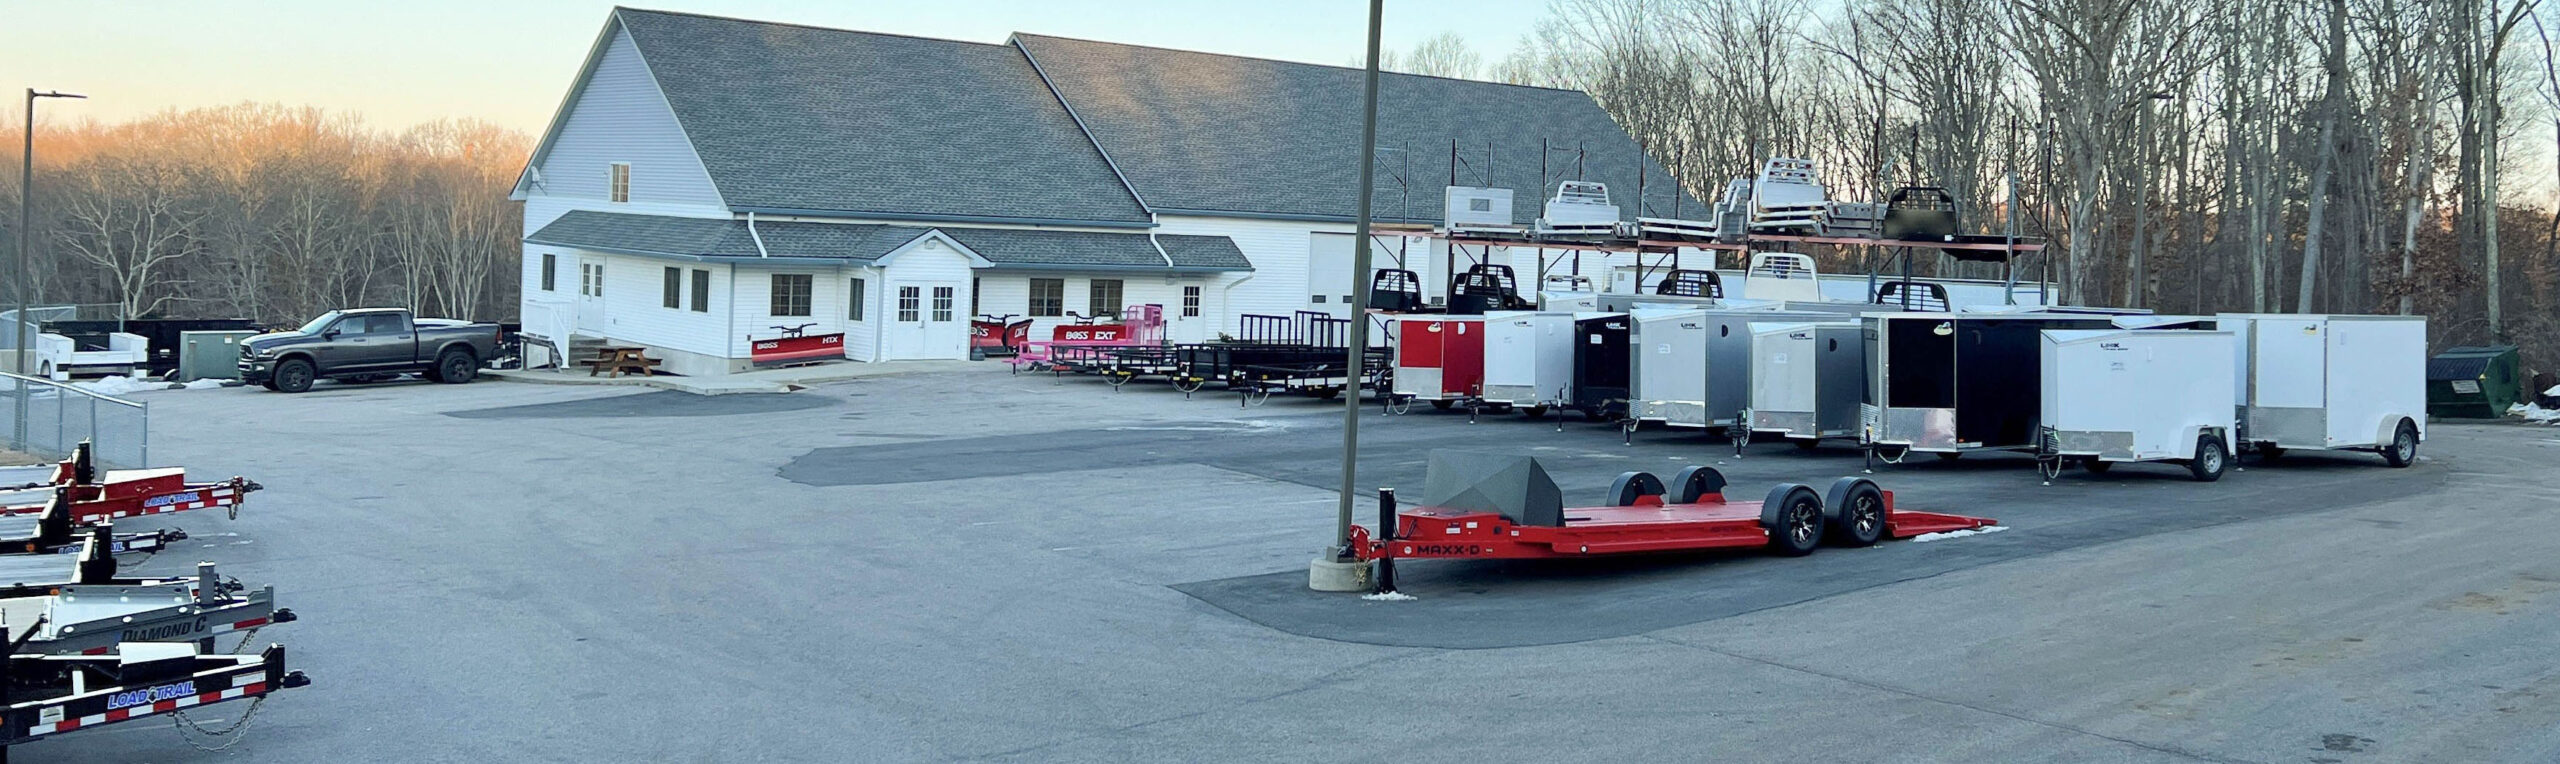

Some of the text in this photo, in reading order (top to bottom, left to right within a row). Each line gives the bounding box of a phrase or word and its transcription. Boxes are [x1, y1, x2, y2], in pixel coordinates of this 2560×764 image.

[1066, 331, 1116, 340] BOSS EXT
[144, 492, 199, 507] LOAD TRAIL
[122, 616, 207, 641] DIAMOND C
[108, 681, 197, 710] LOAD TRAIL
